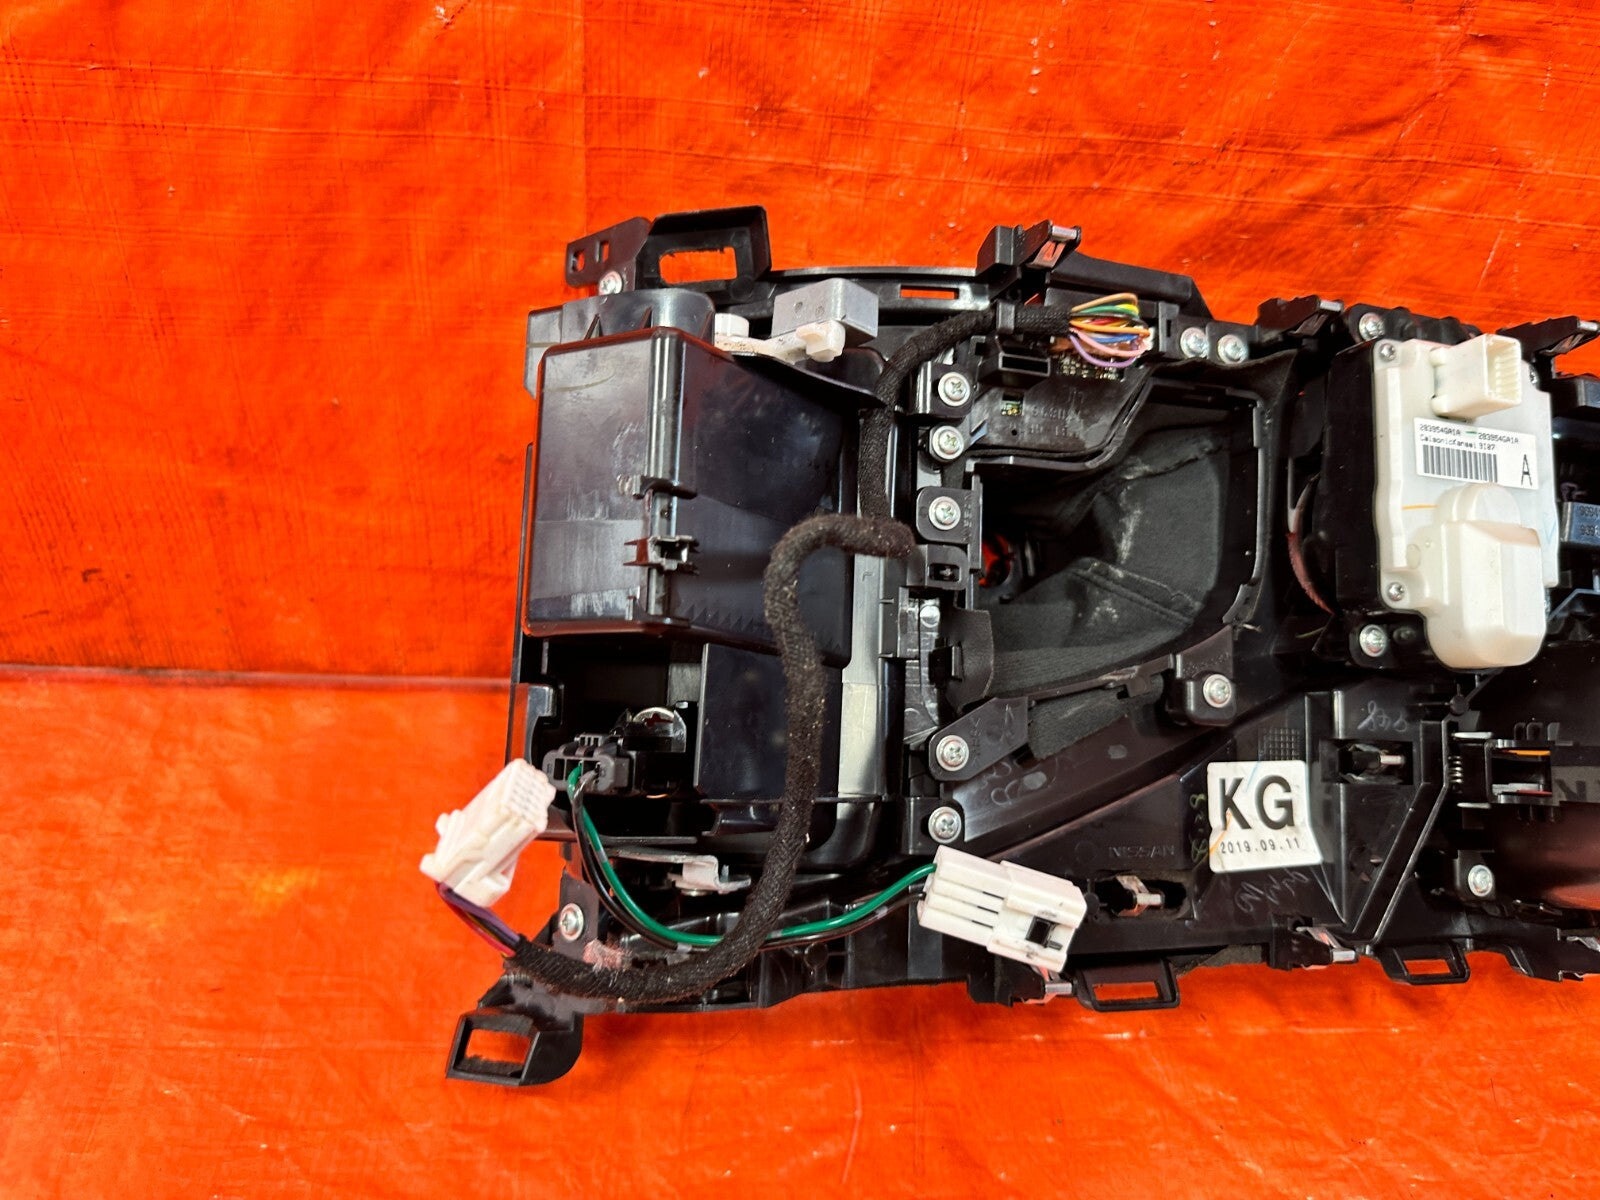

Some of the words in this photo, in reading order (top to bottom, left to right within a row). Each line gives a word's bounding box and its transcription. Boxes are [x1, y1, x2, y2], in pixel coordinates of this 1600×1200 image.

[1521, 454, 1532, 486] A
[1219, 774, 1295, 831] KG
[1220, 837, 1300, 855] 2019.09.11
